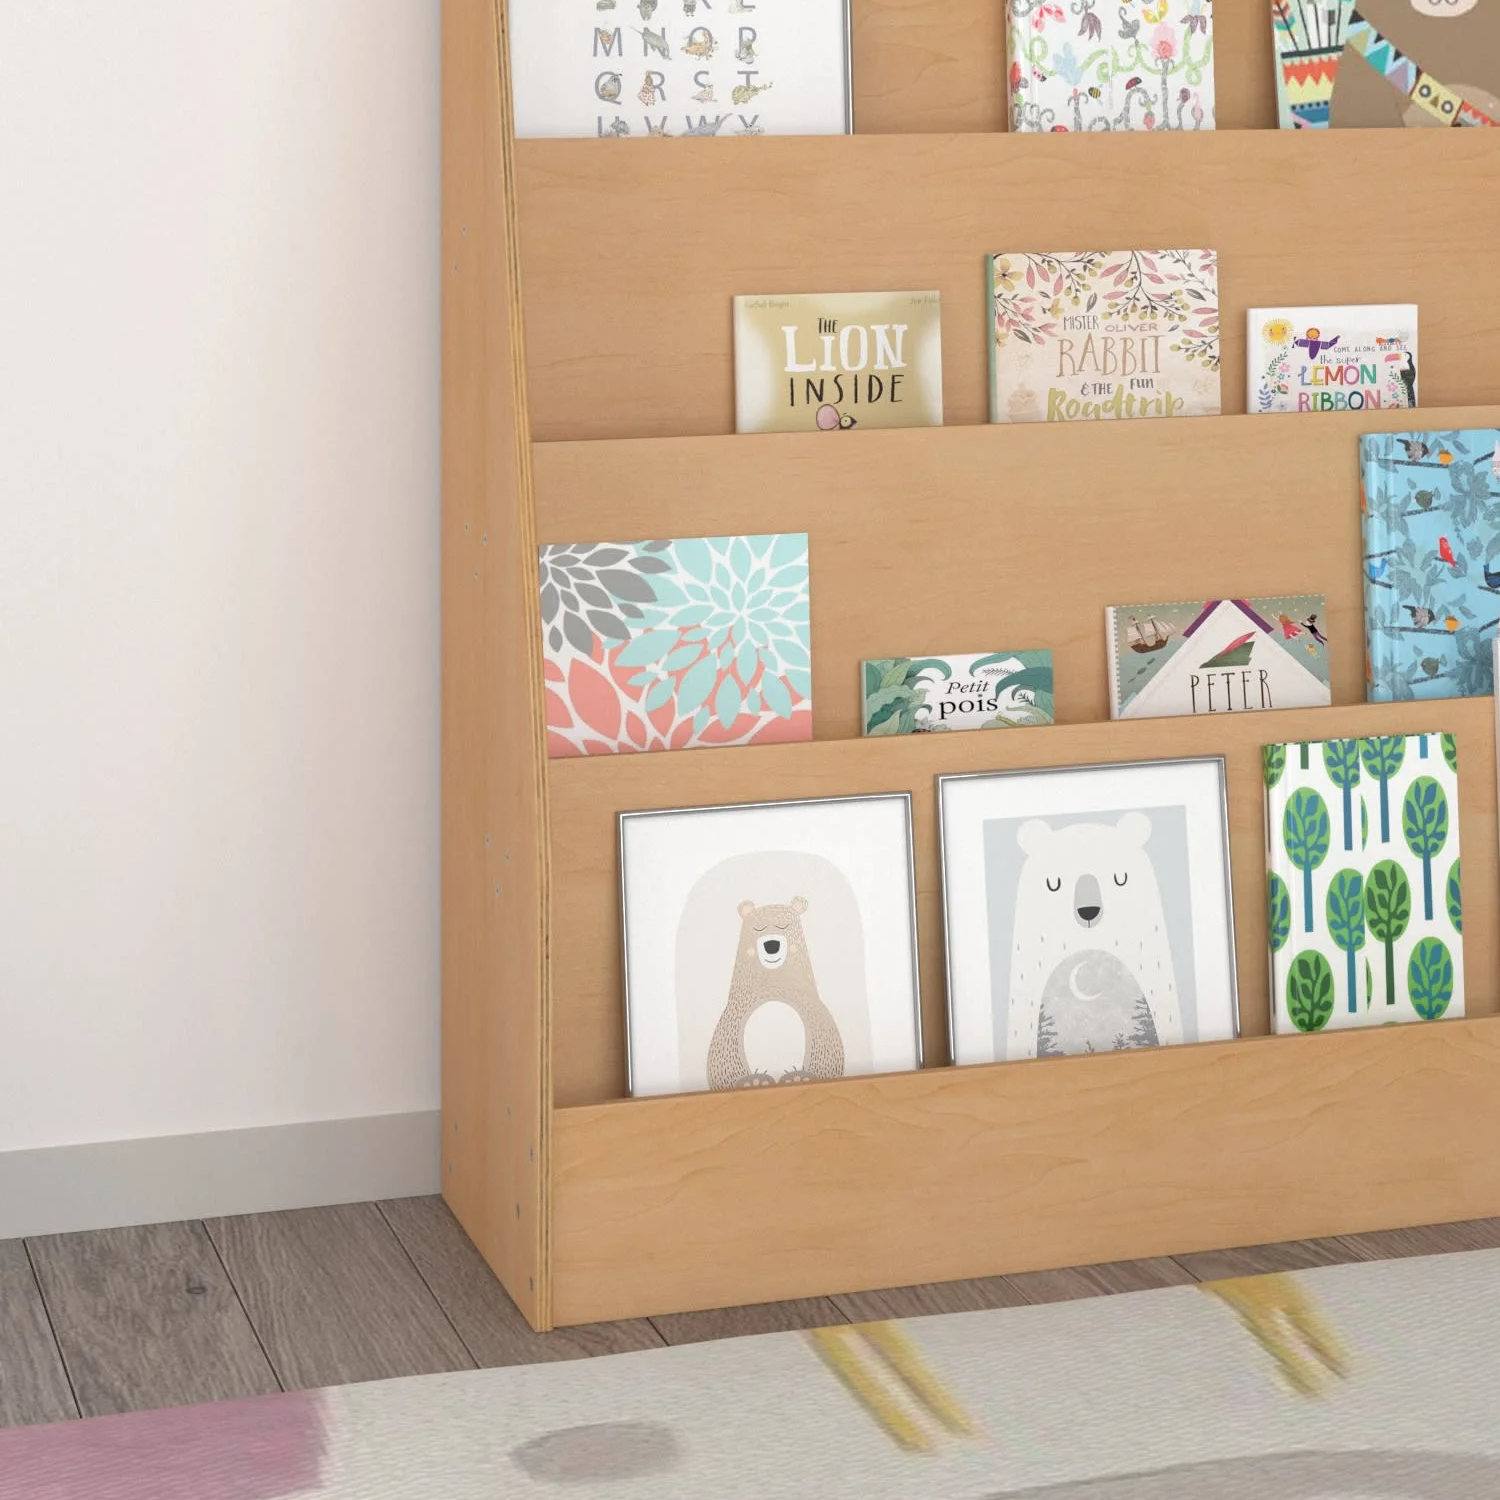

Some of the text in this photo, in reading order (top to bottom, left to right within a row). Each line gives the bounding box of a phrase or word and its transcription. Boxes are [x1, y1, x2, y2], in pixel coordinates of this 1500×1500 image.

[592, 27, 623, 57] M
[594, 71, 622, 105] Q
[645, 71, 666, 101] R
[817, 318, 838, 333] THE
[1063, 315, 1158, 333] MISTER OLIVER
[781, 324, 908, 372] LION
[1056, 332, 1167, 377] RABBIT
[1320, 354, 1360, 366] the super
[1333, 346, 1350, 354] COME
[1300, 364, 1376, 386] LEMON
[790, 374, 905, 406] INSIDE
[1298, 389, 1382, 412] RIBBON
[945, 679, 989, 694] Petit
[1190, 669, 1272, 713] PETER
[938, 694, 998, 720] pois
